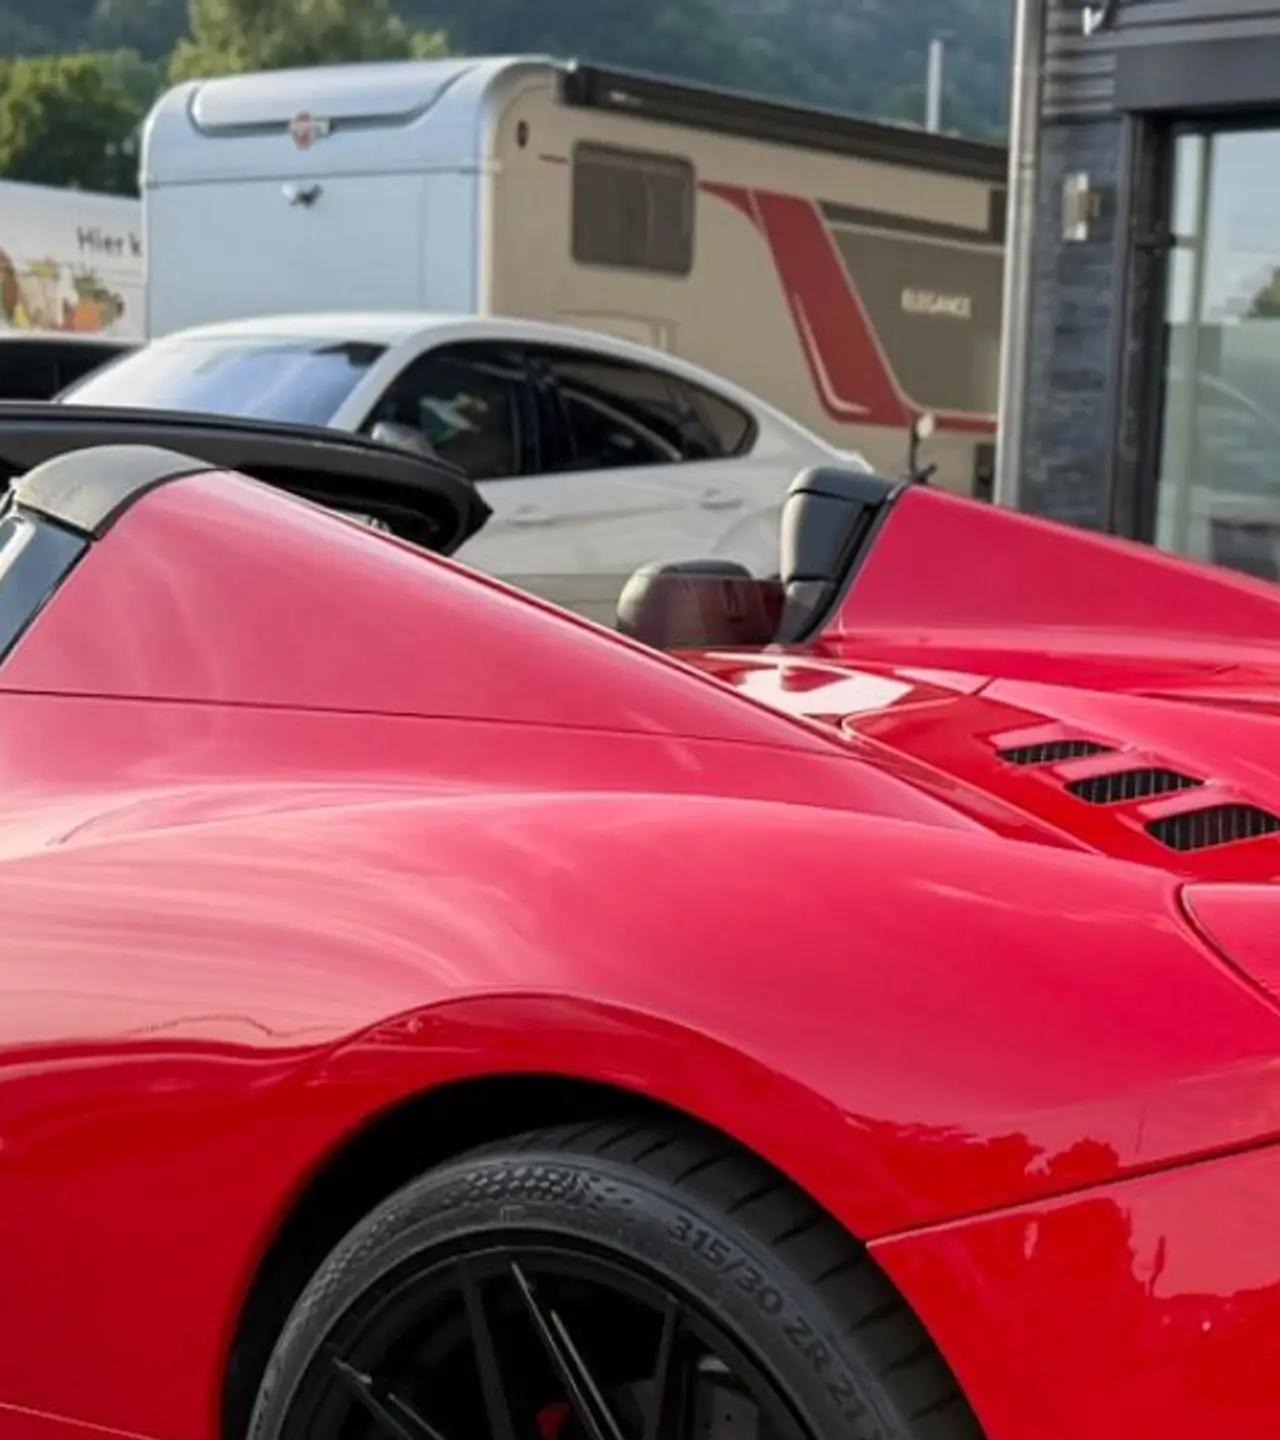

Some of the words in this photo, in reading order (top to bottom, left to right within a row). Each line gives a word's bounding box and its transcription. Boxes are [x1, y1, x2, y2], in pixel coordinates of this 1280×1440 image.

[76, 224, 123, 257] Hier
[901, 287, 972, 319] ELEGANCE
[668, 1214, 784, 1315] 315/30
